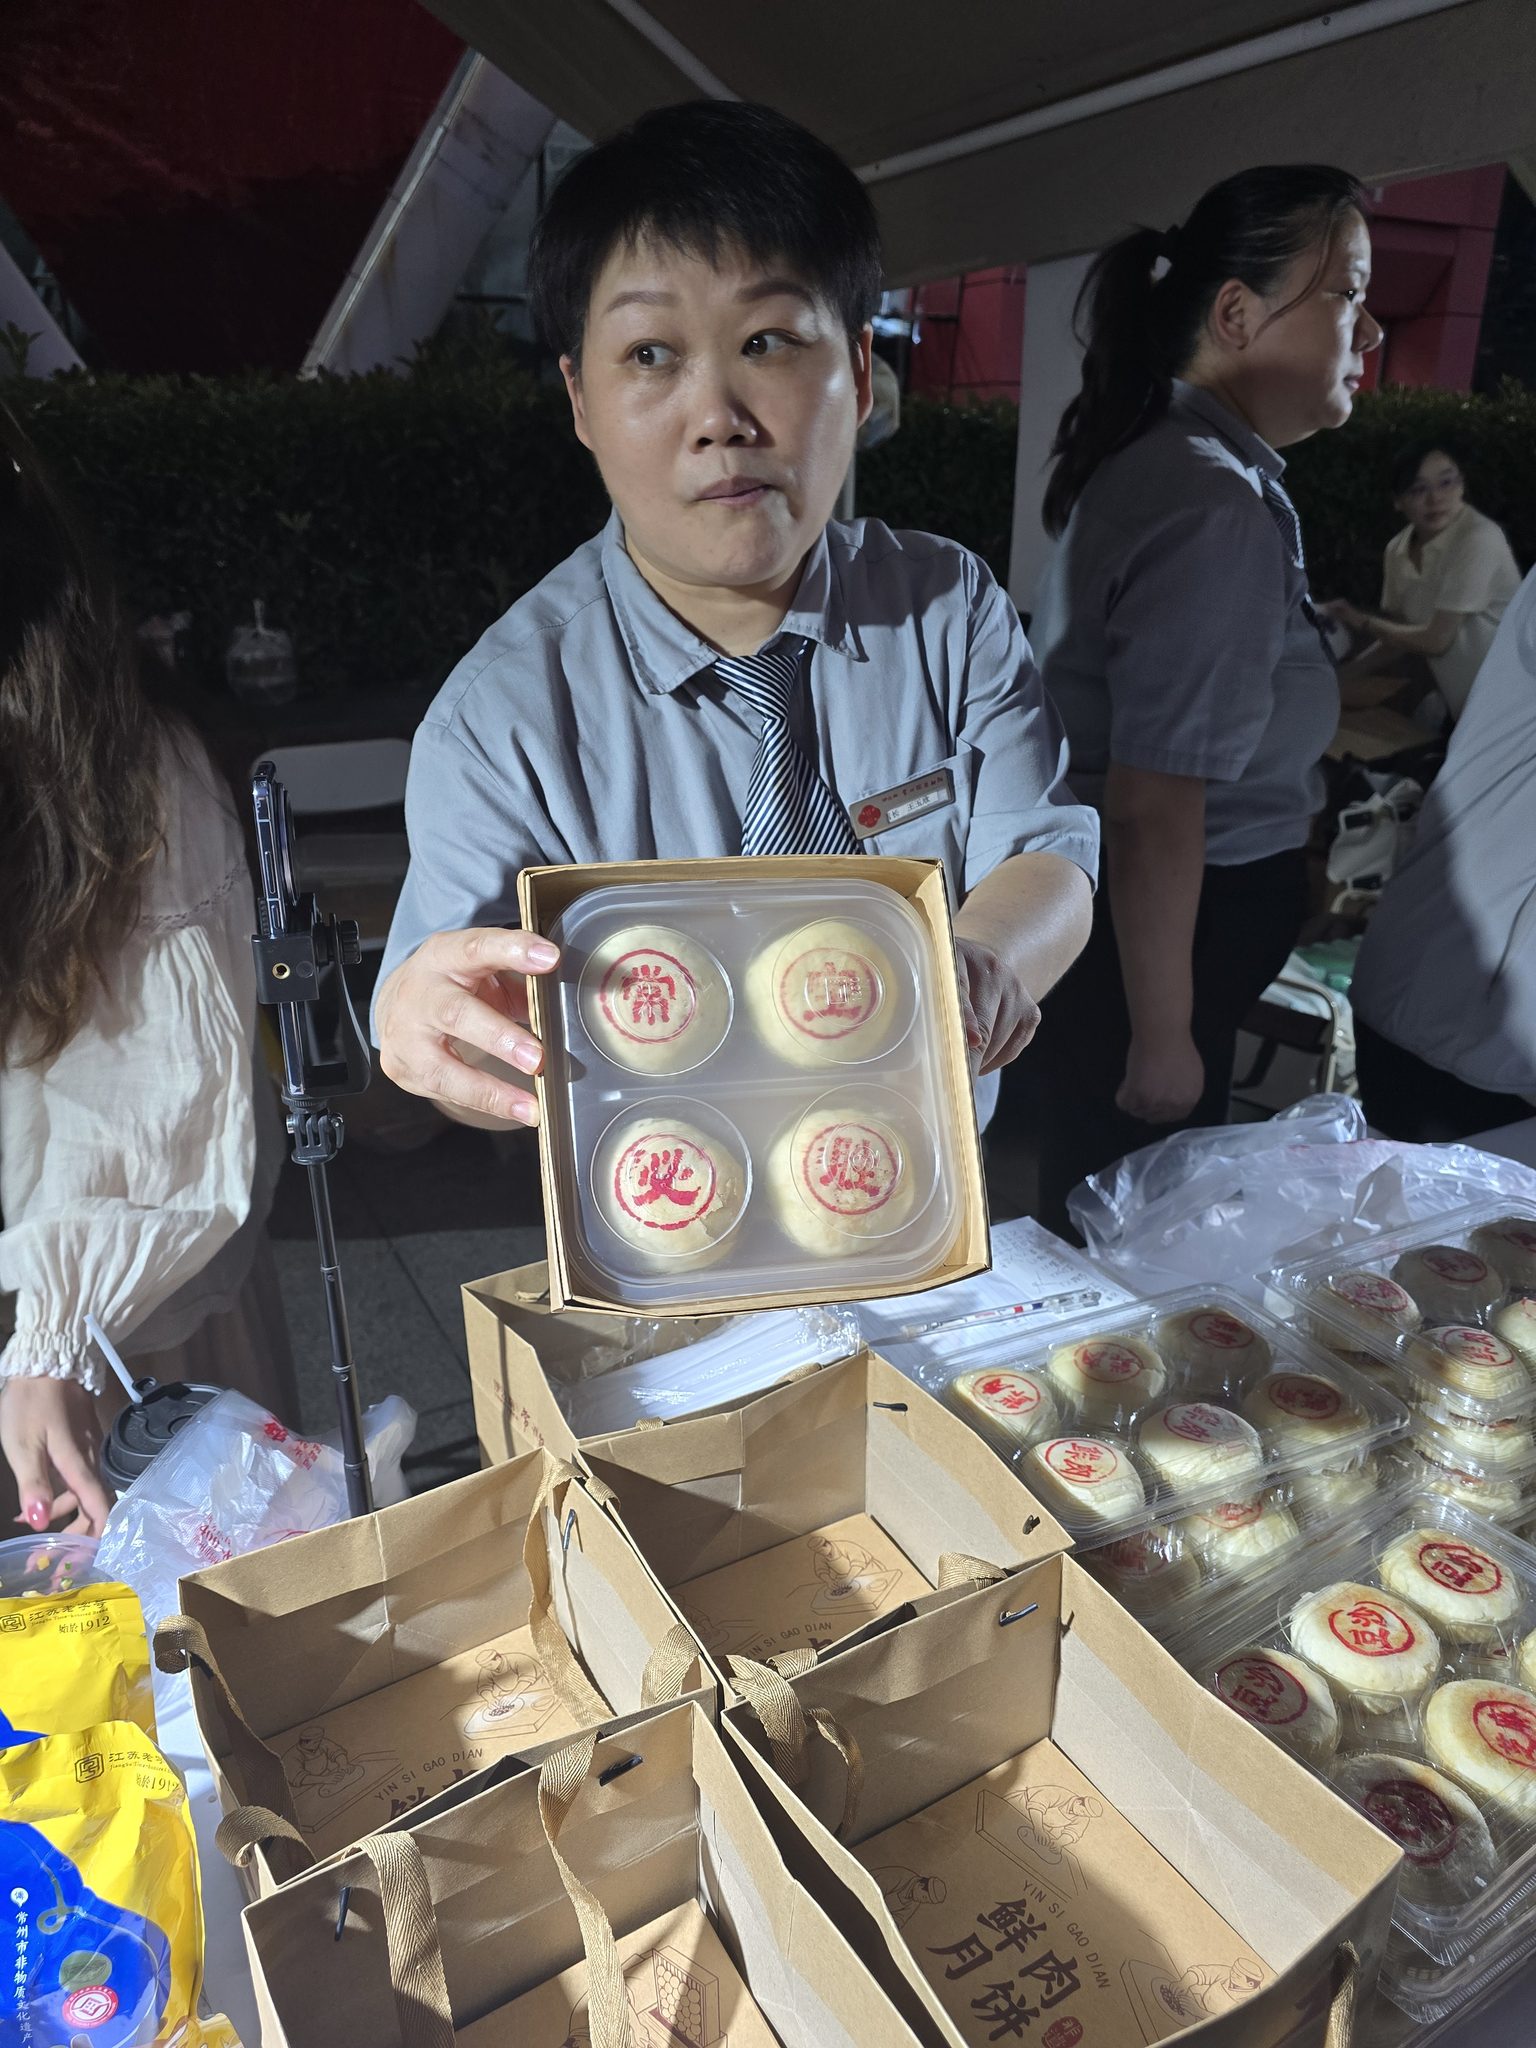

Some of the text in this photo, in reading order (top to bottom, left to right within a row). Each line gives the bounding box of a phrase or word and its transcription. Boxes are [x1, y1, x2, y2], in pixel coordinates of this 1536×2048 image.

[1060, 1442, 1104, 1478] 鲜肉
[763, 1636, 777, 1648] SI
[780, 1627, 801, 1639] GAO
[804, 1621, 833, 1633] DIAN
[1345, 1605, 1394, 1649] 豆沙
[374, 1747, 484, 1801] YIN SI GAO DIAN
[976, 1898, 1082, 2010] 鲜肉
[1023, 1879, 1112, 1990] YIN SI GAO DIAN
[926, 1931, 1041, 2042] 月饼
